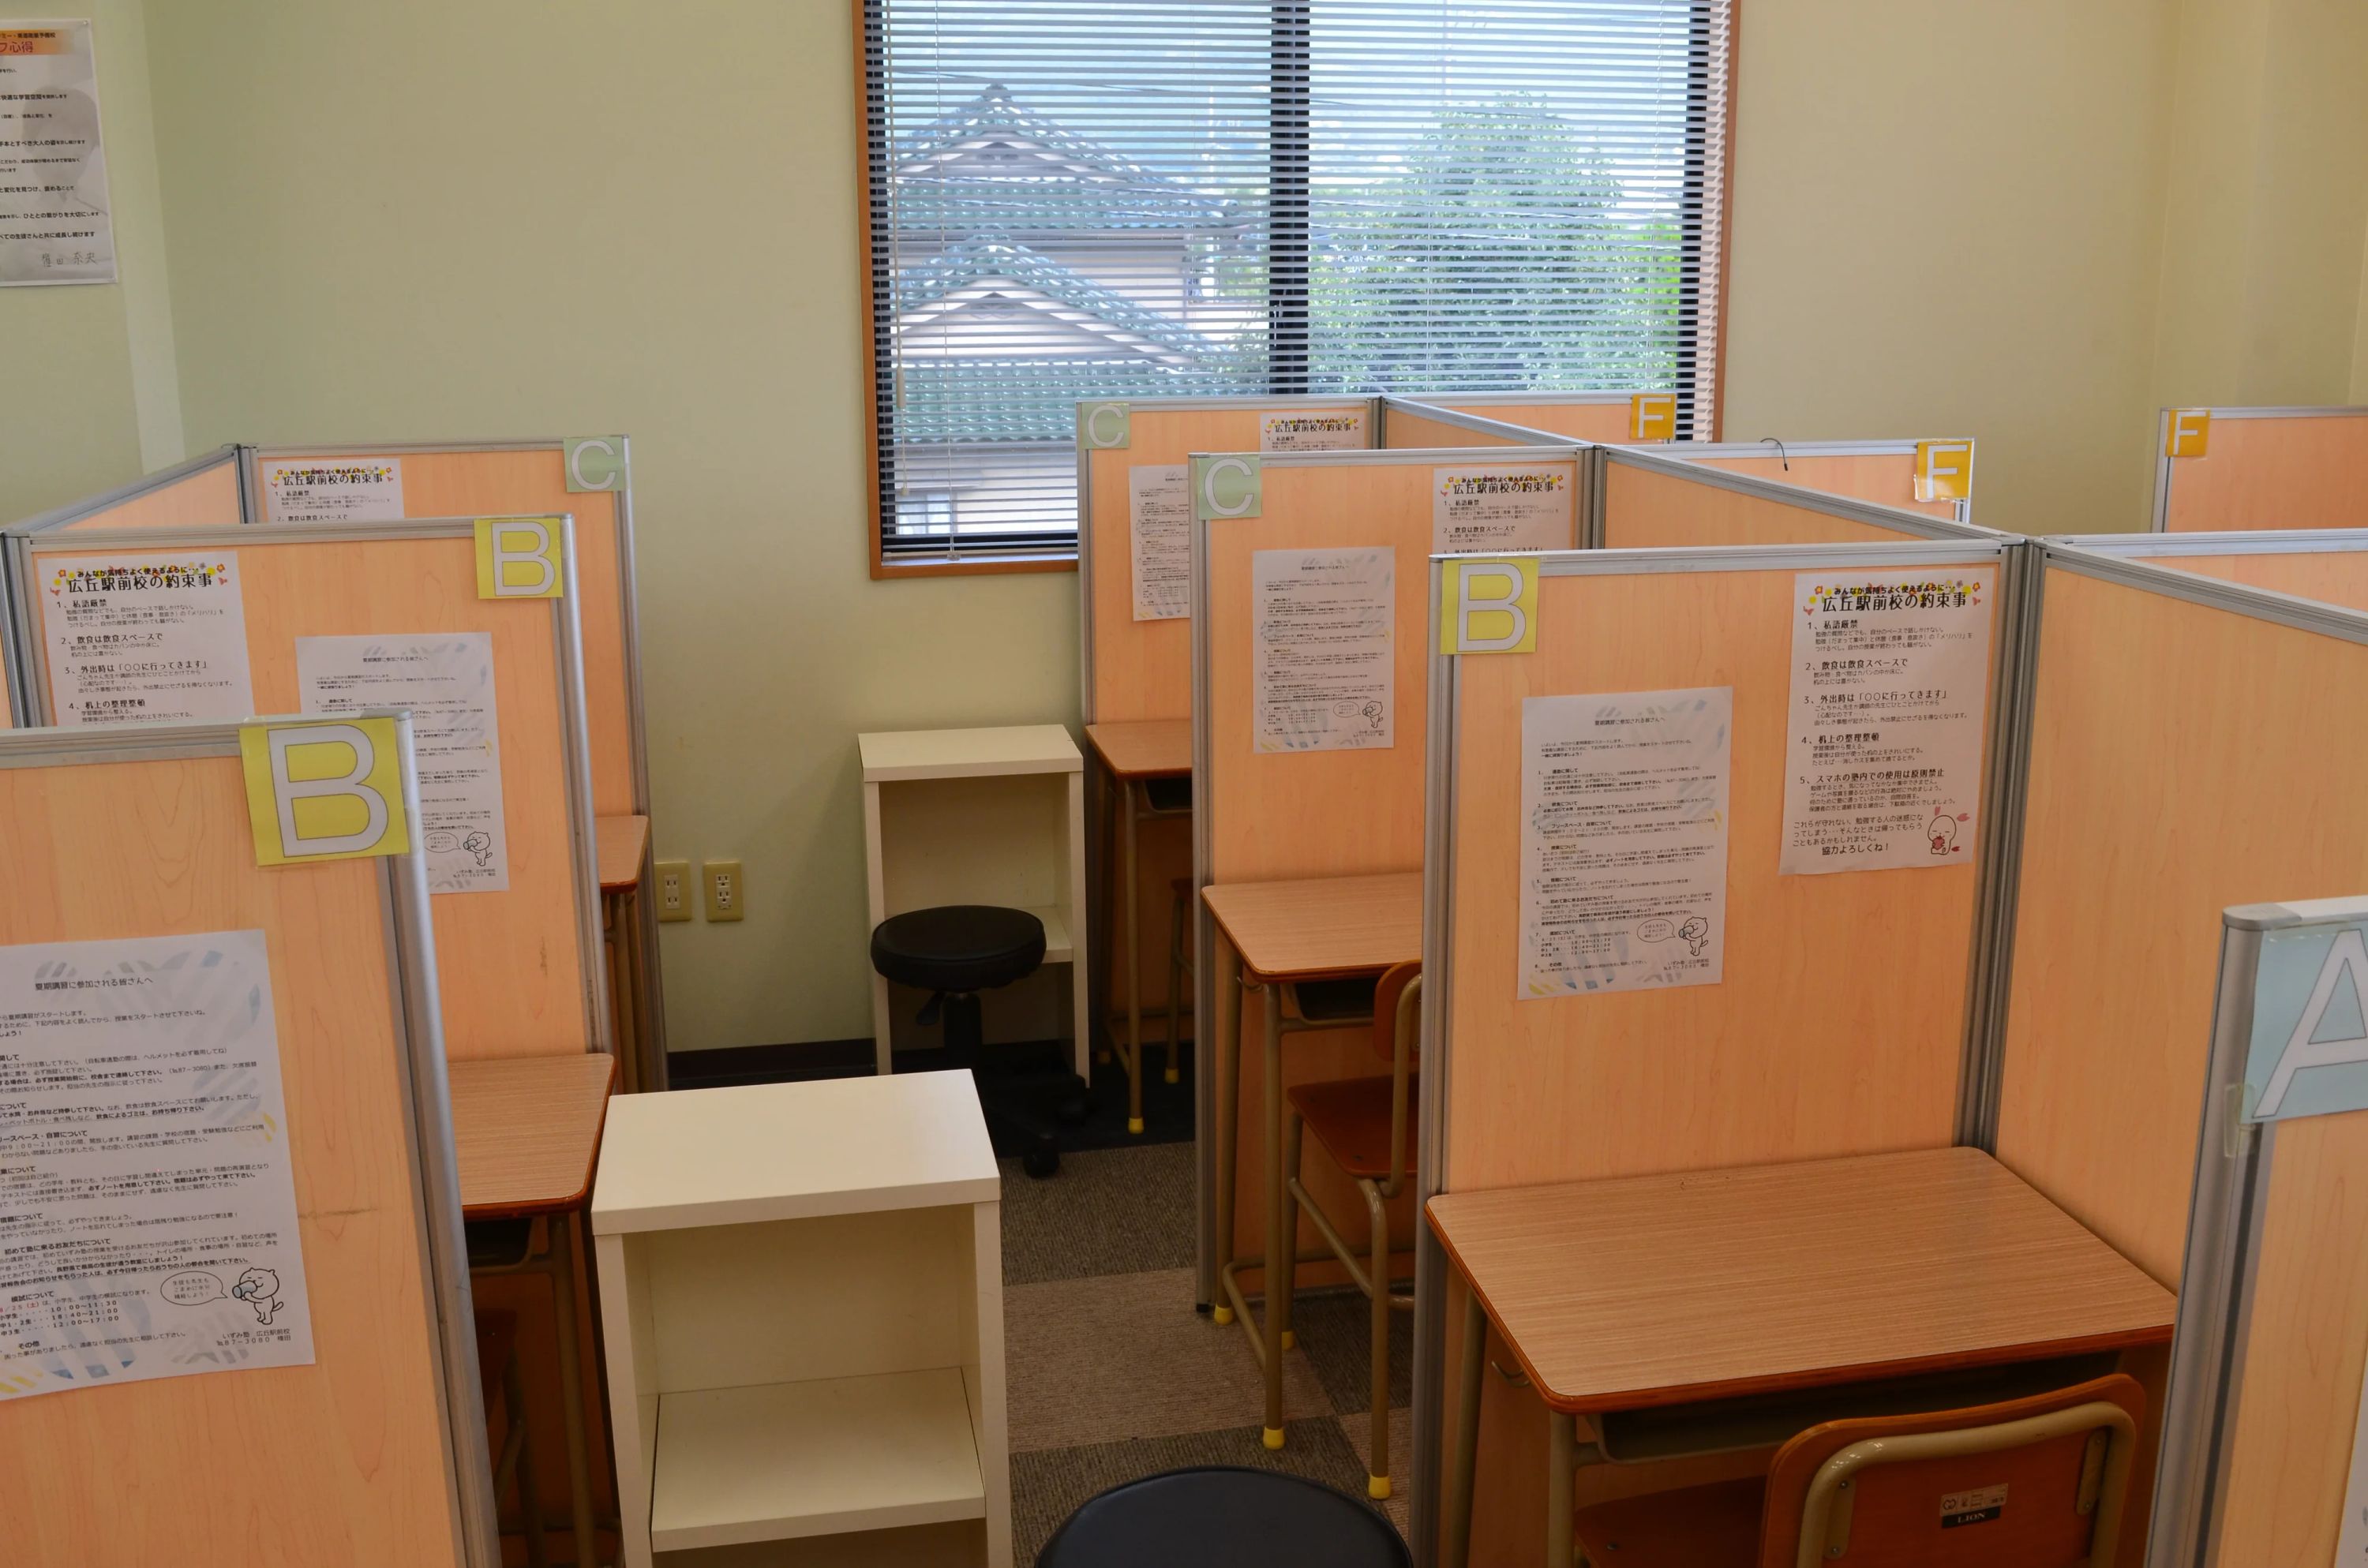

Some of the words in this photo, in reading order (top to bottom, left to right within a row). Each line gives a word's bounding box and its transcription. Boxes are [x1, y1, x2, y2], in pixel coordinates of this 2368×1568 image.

[1088, 405, 1124, 447] C
[1638, 397, 1671, 438] F
[2173, 411, 2207, 455] F
[571, 440, 616, 489] C
[1926, 444, 1968, 500] F
[1205, 458, 1254, 516] C
[491, 521, 556, 596] B
[1457, 562, 1527, 652] B
[1823, 593, 1967, 613] 広丘駅前校の約束事
[1805, 659, 1908, 671] 2、飲食は飲食スペースで
[1802, 732, 1879, 744] 4、机上の整理整頓
[1800, 769, 1945, 784] 5、スマホの塾内での使用は原則禁止
[267, 724, 389, 858] B
[1793, 815, 1923, 828] これらが守れない、勉強する人の迷惑にな
[1793, 837, 1877, 847] こともあるかもしれません。
[1822, 843, 1889, 855] 協力よろしくね！
[35, 977, 154, 990] 夏期講習に参加される皆さんへ
[0, 1010, 86, 1021] ら夏期講習がスタートします。
[2252, 928, 2368, 1118] A
[4, 1238, 111, 1256] 初めて塾に来るお友だちについて
[1958, 1512, 1985, 1523] LION
